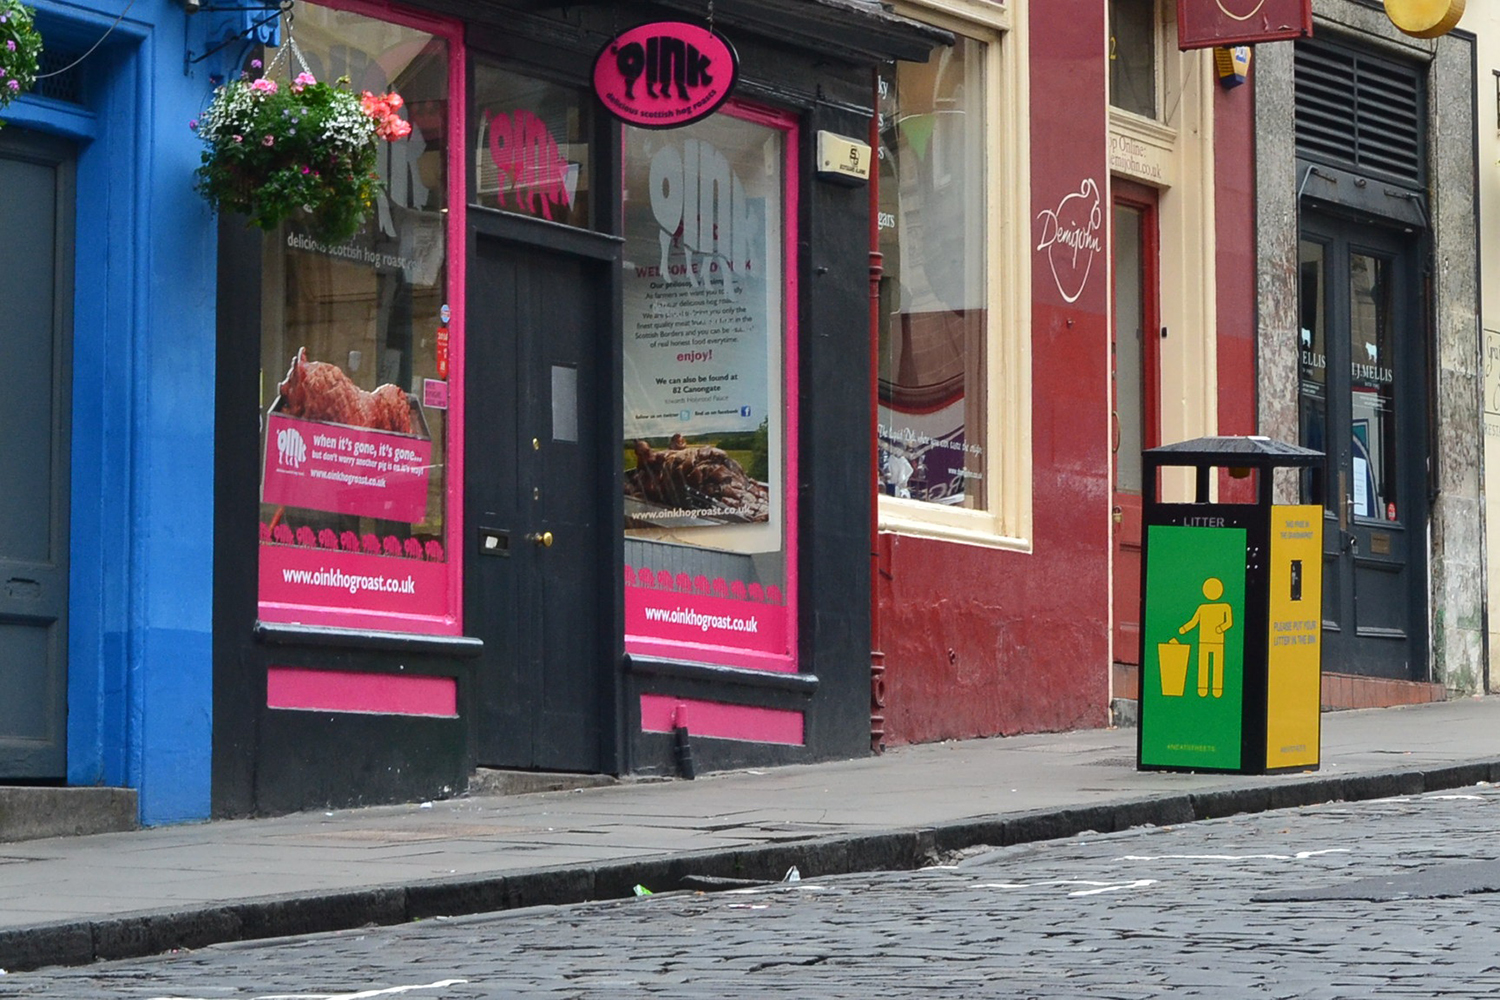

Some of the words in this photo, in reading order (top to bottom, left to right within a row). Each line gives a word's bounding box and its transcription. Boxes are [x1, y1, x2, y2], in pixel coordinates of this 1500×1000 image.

[606, 92, 638, 115] delicious
[640, 110, 674, 118] scottish
[675, 107, 693, 116] hog
[693, 89, 718, 110] roasts
[1110, 154, 1161, 179] emijohn.co.uk
[877, 211, 896, 231] gars
[1037, 209, 1101, 269] Demijohn
[364, 247, 381, 268] hog
[650, 281, 665, 289] Our
[706, 289, 717, 297] you
[680, 299, 705, 307] delicious
[722, 307, 735, 315] only
[636, 322, 652, 330] finest
[654, 321, 674, 330] quality
[635, 332, 659, 340] Scottish
[660, 330, 684, 338] Borders
[658, 340, 669, 348] real
[692, 337, 706, 345] food
[677, 350, 713, 363] enjoy!
[1302, 350, 1326, 369] ELLIS
[682, 376, 696, 384] also
[698, 375, 707, 383] be
[708, 374, 729, 382] found
[672, 386, 682, 394] 82
[683, 384, 721, 395] Canongate
[313, 434, 337, 449] when
[338, 436, 352, 451] it's
[353, 441, 377, 458] gone,
[379, 442, 393, 458] it's
[311, 450, 322, 459] but
[323, 451, 338, 462] don't
[339, 456, 355, 467] worry
[356, 458, 377, 468] another
[378, 461, 387, 472] pig
[387, 462, 392, 470] is
[310, 469, 387, 488] www.oinkhogroast.co.uk
[632, 504, 751, 519] www.oinkhogroast.co.uk
[1183, 516, 1225, 528] LITTER
[282, 567, 416, 594] www.oinkhogroast.co.uk
[645, 606, 758, 633] www.oinkhogroast.co.uk
[1273, 621, 1292, 632] PLEASE
[1293, 621, 1304, 631] PUT
[1304, 620, 1317, 631] YOUR
[1273, 635, 1290, 646] LITTER
[1298, 635, 1307, 644] THE
[1307, 634, 1316, 644] BIN
